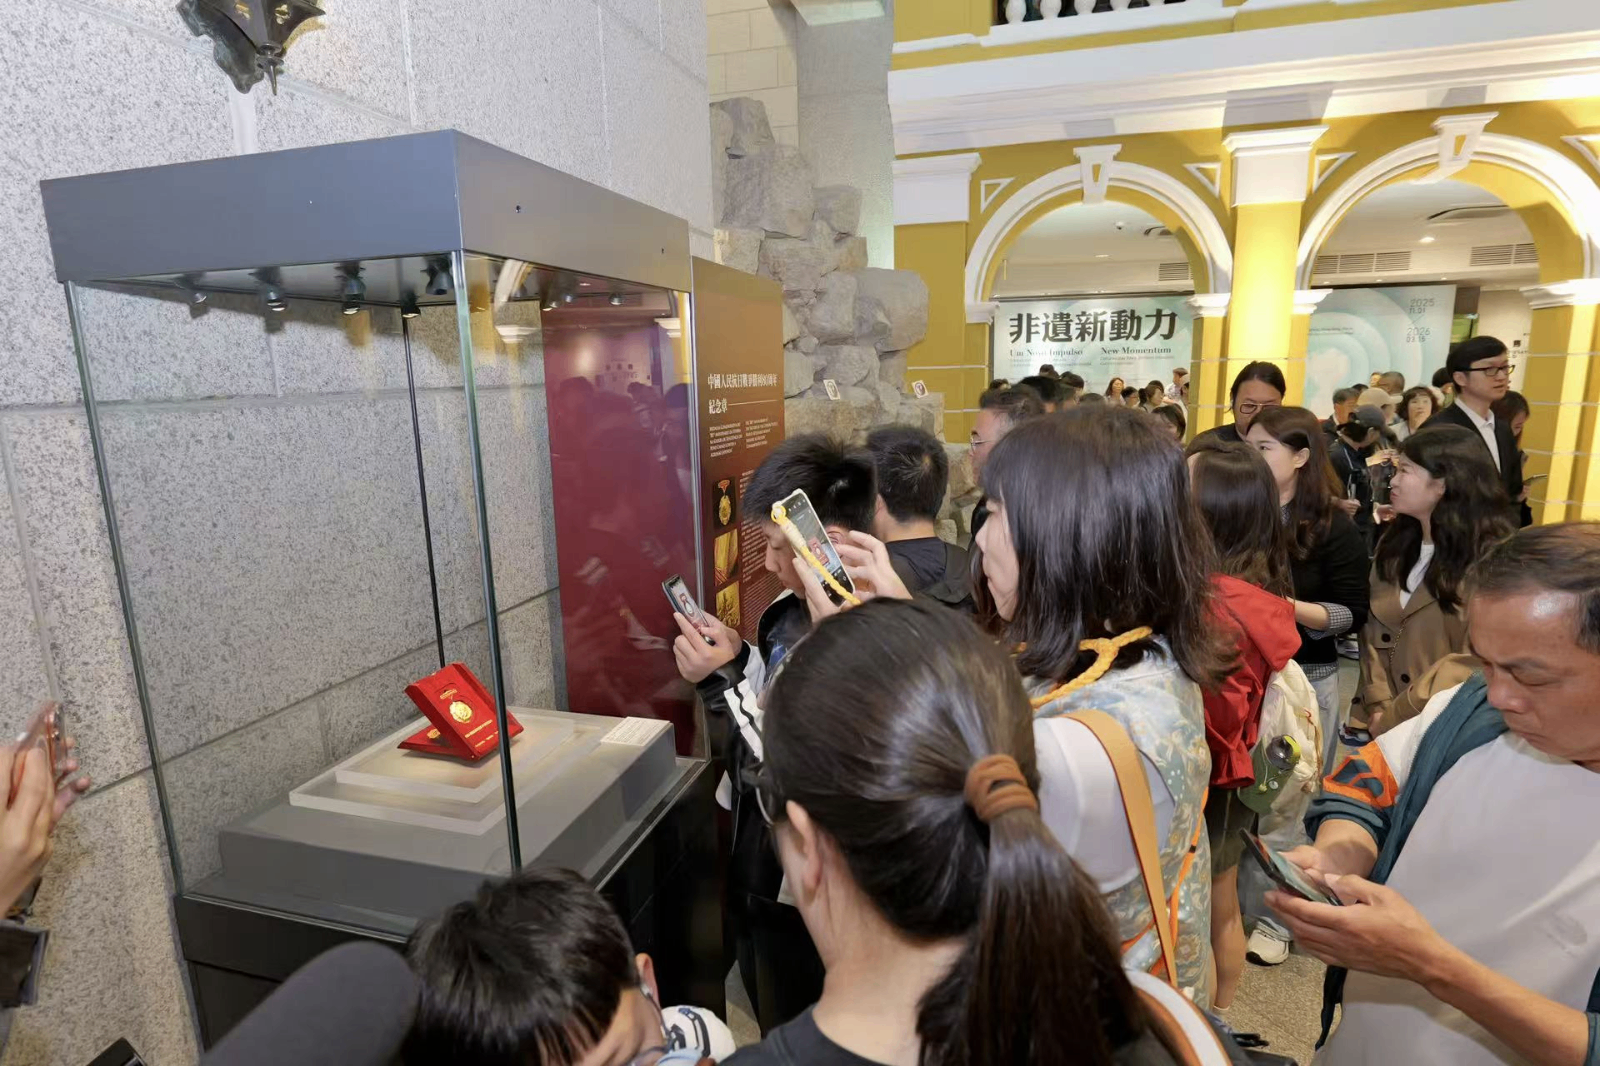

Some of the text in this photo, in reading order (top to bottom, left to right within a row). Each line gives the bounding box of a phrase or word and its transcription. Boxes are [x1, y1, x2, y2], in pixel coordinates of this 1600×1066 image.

[1410, 298, 1435, 307] 2025
[1009, 308, 1178, 344] 非遺新動力
[1406, 327, 1431, 336] 2026
[1050, 348, 1083, 358] Impulso
[1101, 346, 1172, 355] New Momentum
[708, 398, 727, 414] 紀念章
